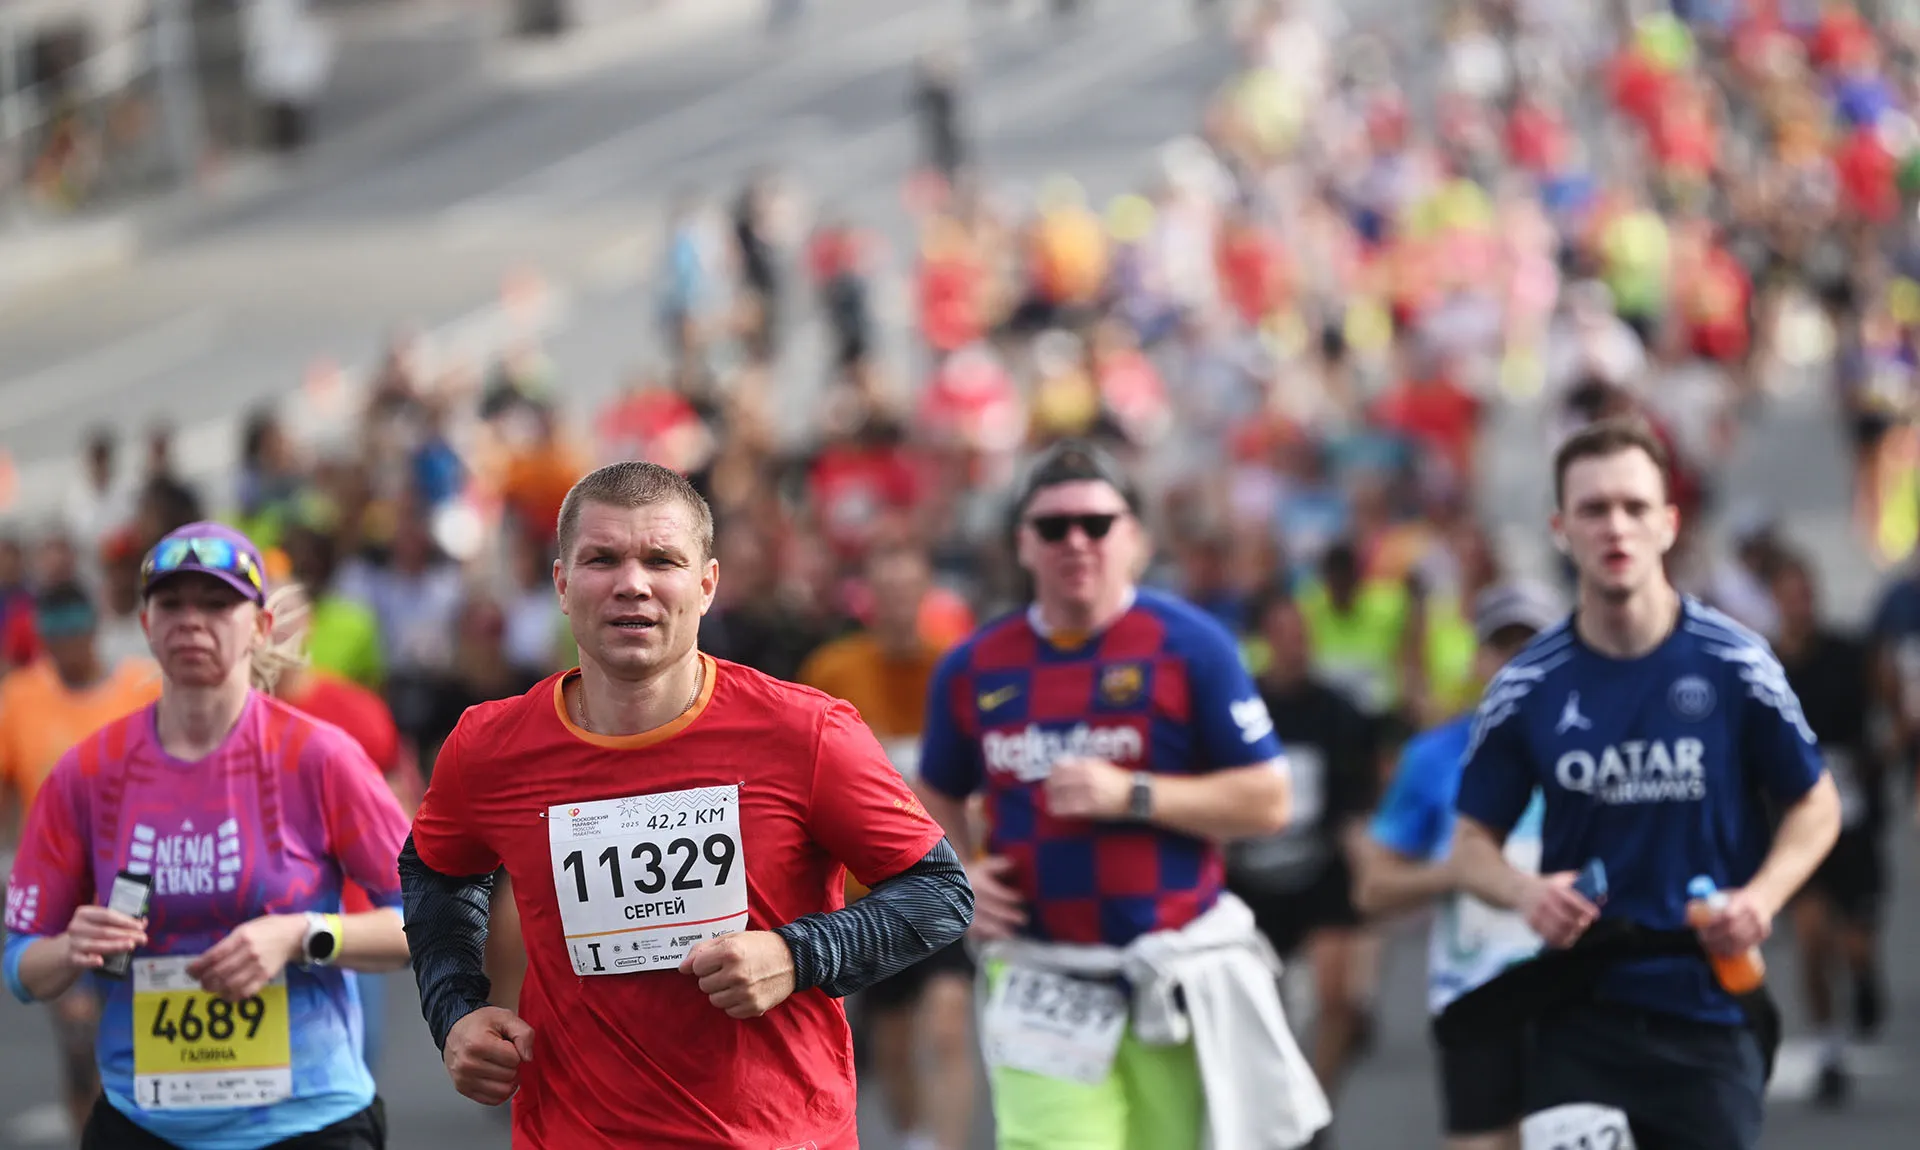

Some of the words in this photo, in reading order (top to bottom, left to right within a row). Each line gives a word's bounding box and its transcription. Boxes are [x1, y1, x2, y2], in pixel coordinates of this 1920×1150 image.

[1555, 737, 1706, 795] QATAR
[571, 820, 599, 828] МАРАФОН
[620, 820, 640, 829] 2025
[646, 811, 687, 831] 42,2
[562, 832, 736, 903] 11329
[624, 896, 686, 920] СЕРГЕЙ
[151, 994, 266, 1044] 4689
[180, 1047, 237, 1063] ГАЛИНА
